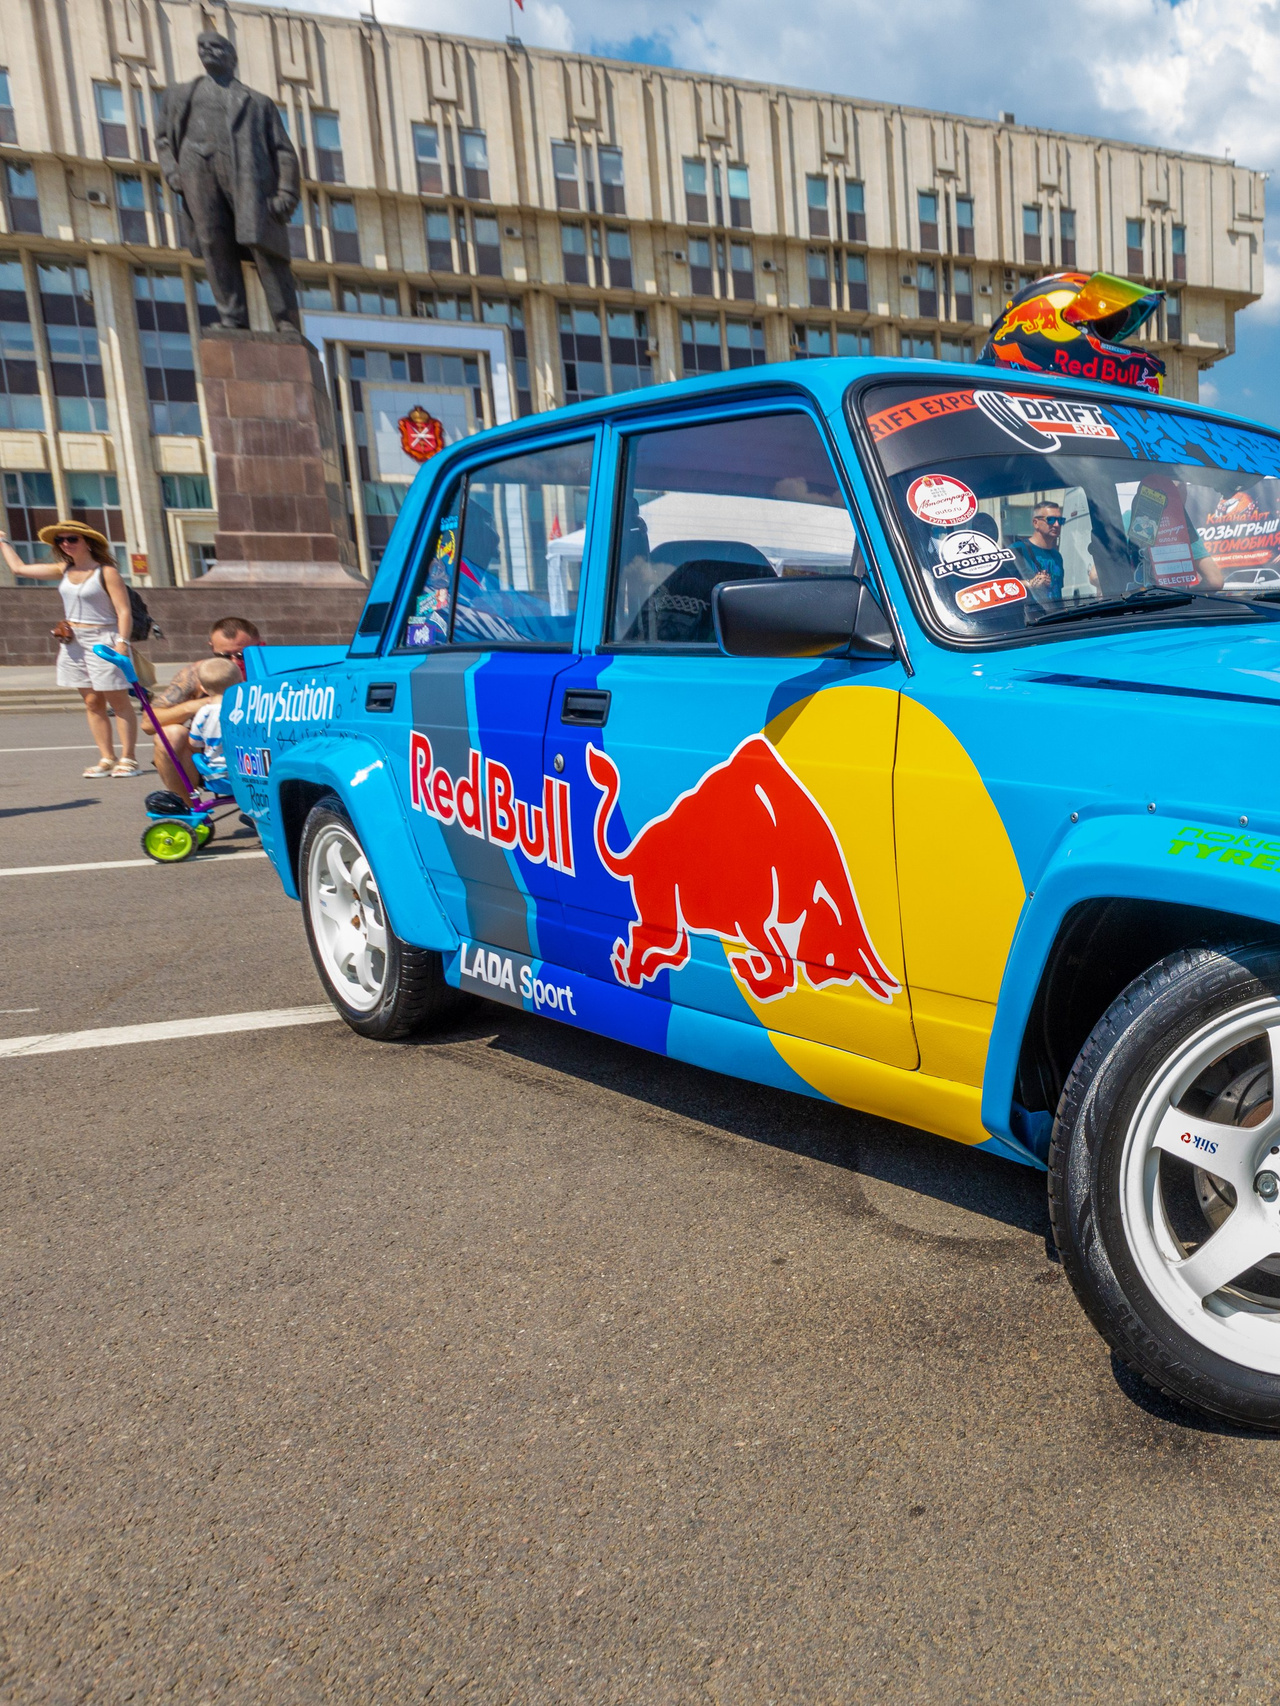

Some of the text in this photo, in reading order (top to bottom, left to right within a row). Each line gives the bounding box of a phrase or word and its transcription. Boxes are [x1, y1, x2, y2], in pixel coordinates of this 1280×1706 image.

[1055, 349, 1098, 378] Red
[1101, 359, 1140, 386] Bull
[870, 394, 974, 439] RIFT EXPO
[1019, 399, 1108, 425] DRIFT
[1073, 423, 1108, 437] EXPO
[935, 507, 961, 515] auto.ru
[1196, 519, 1280, 541] РОЗЫГРЫШ
[938, 551, 1011, 575] AVTOEXPORT
[1158, 574, 1196, 586] SELECTED
[246, 679, 335, 738] PlayStation
[235, 745, 263, 777] Mobil
[409, 730, 576, 878] Red Bull
[459, 943, 577, 1016] LADA Sport
[1192, 1135, 1219, 1154] Slik
